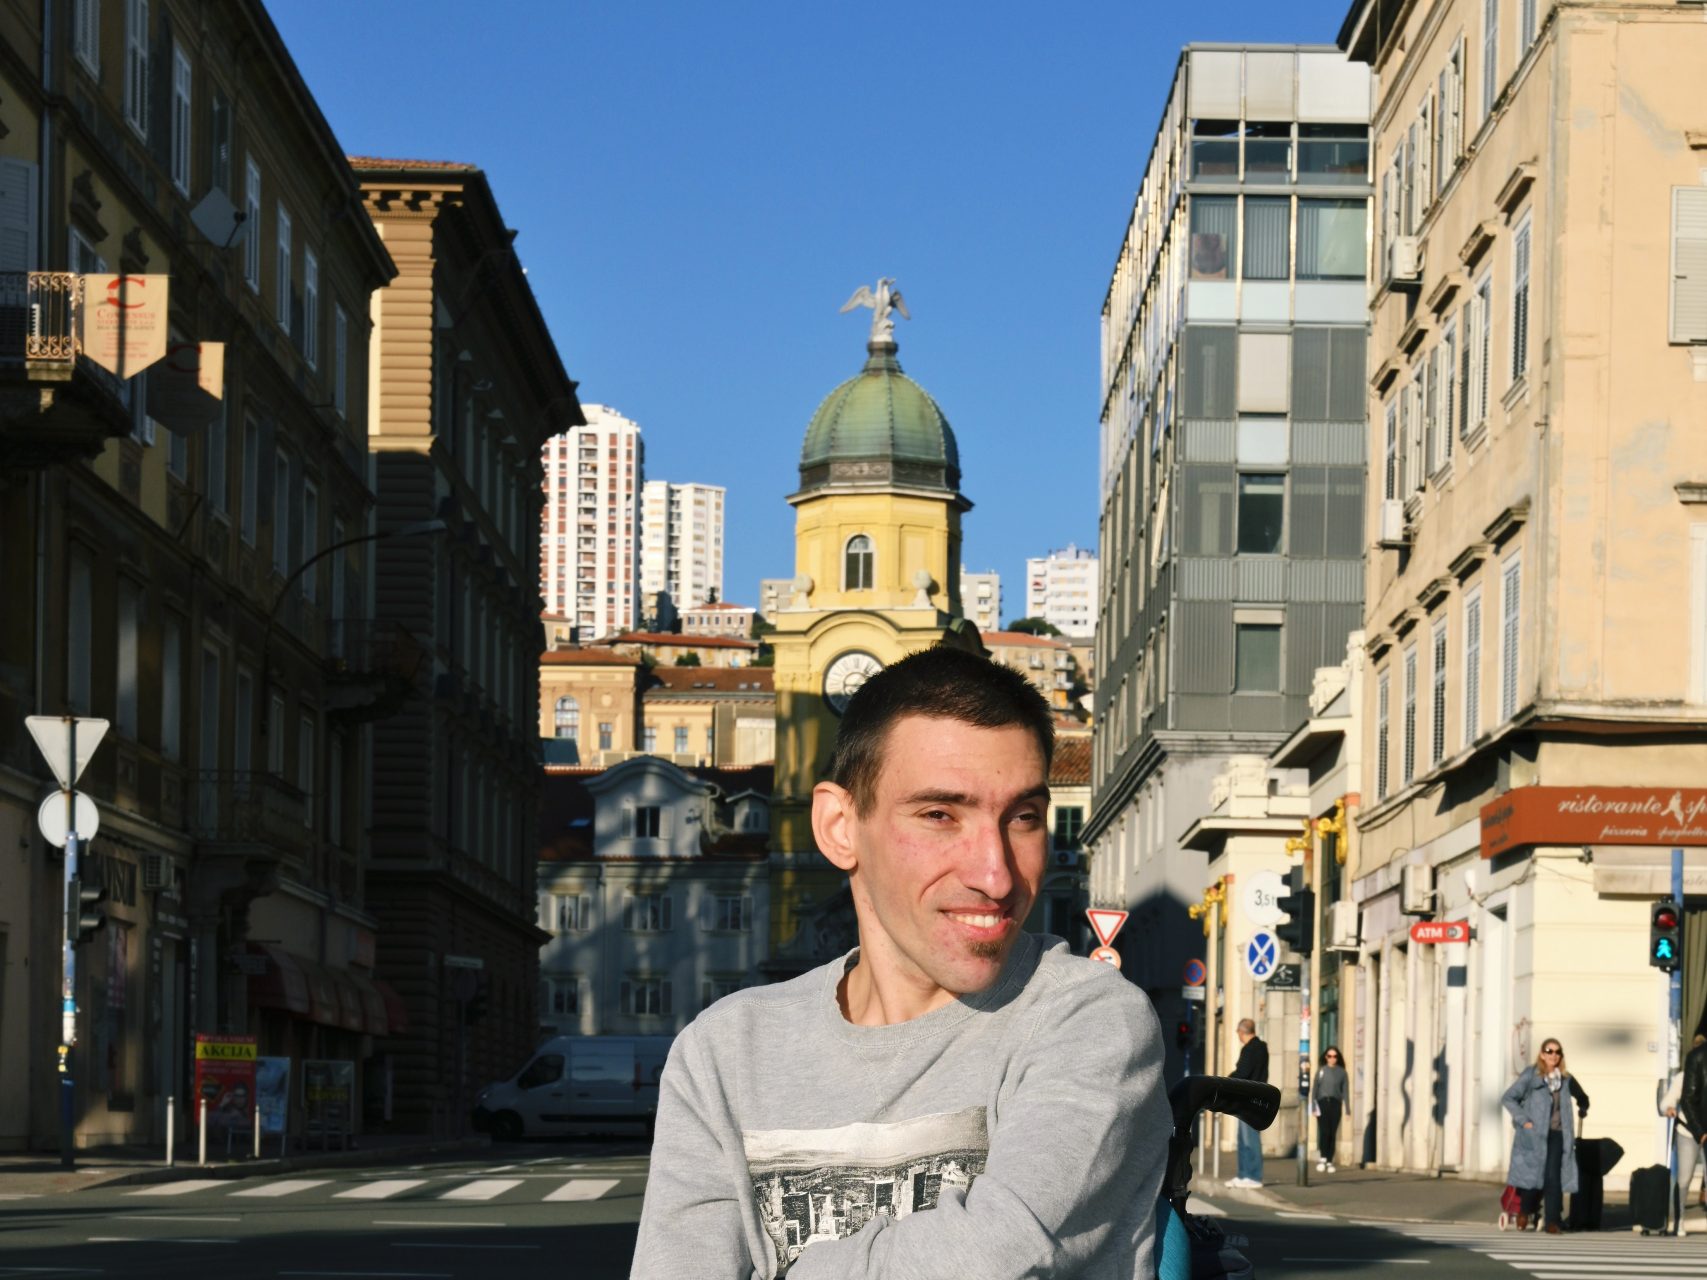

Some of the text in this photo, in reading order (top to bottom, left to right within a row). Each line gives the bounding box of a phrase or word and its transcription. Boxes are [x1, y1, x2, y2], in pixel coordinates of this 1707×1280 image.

[1558, 794, 1662, 815] ristorante
[1600, 825, 1648, 840] pizzeria
[1416, 927, 1443, 938] ATM
[200, 1045, 252, 1058] AKCIJA
